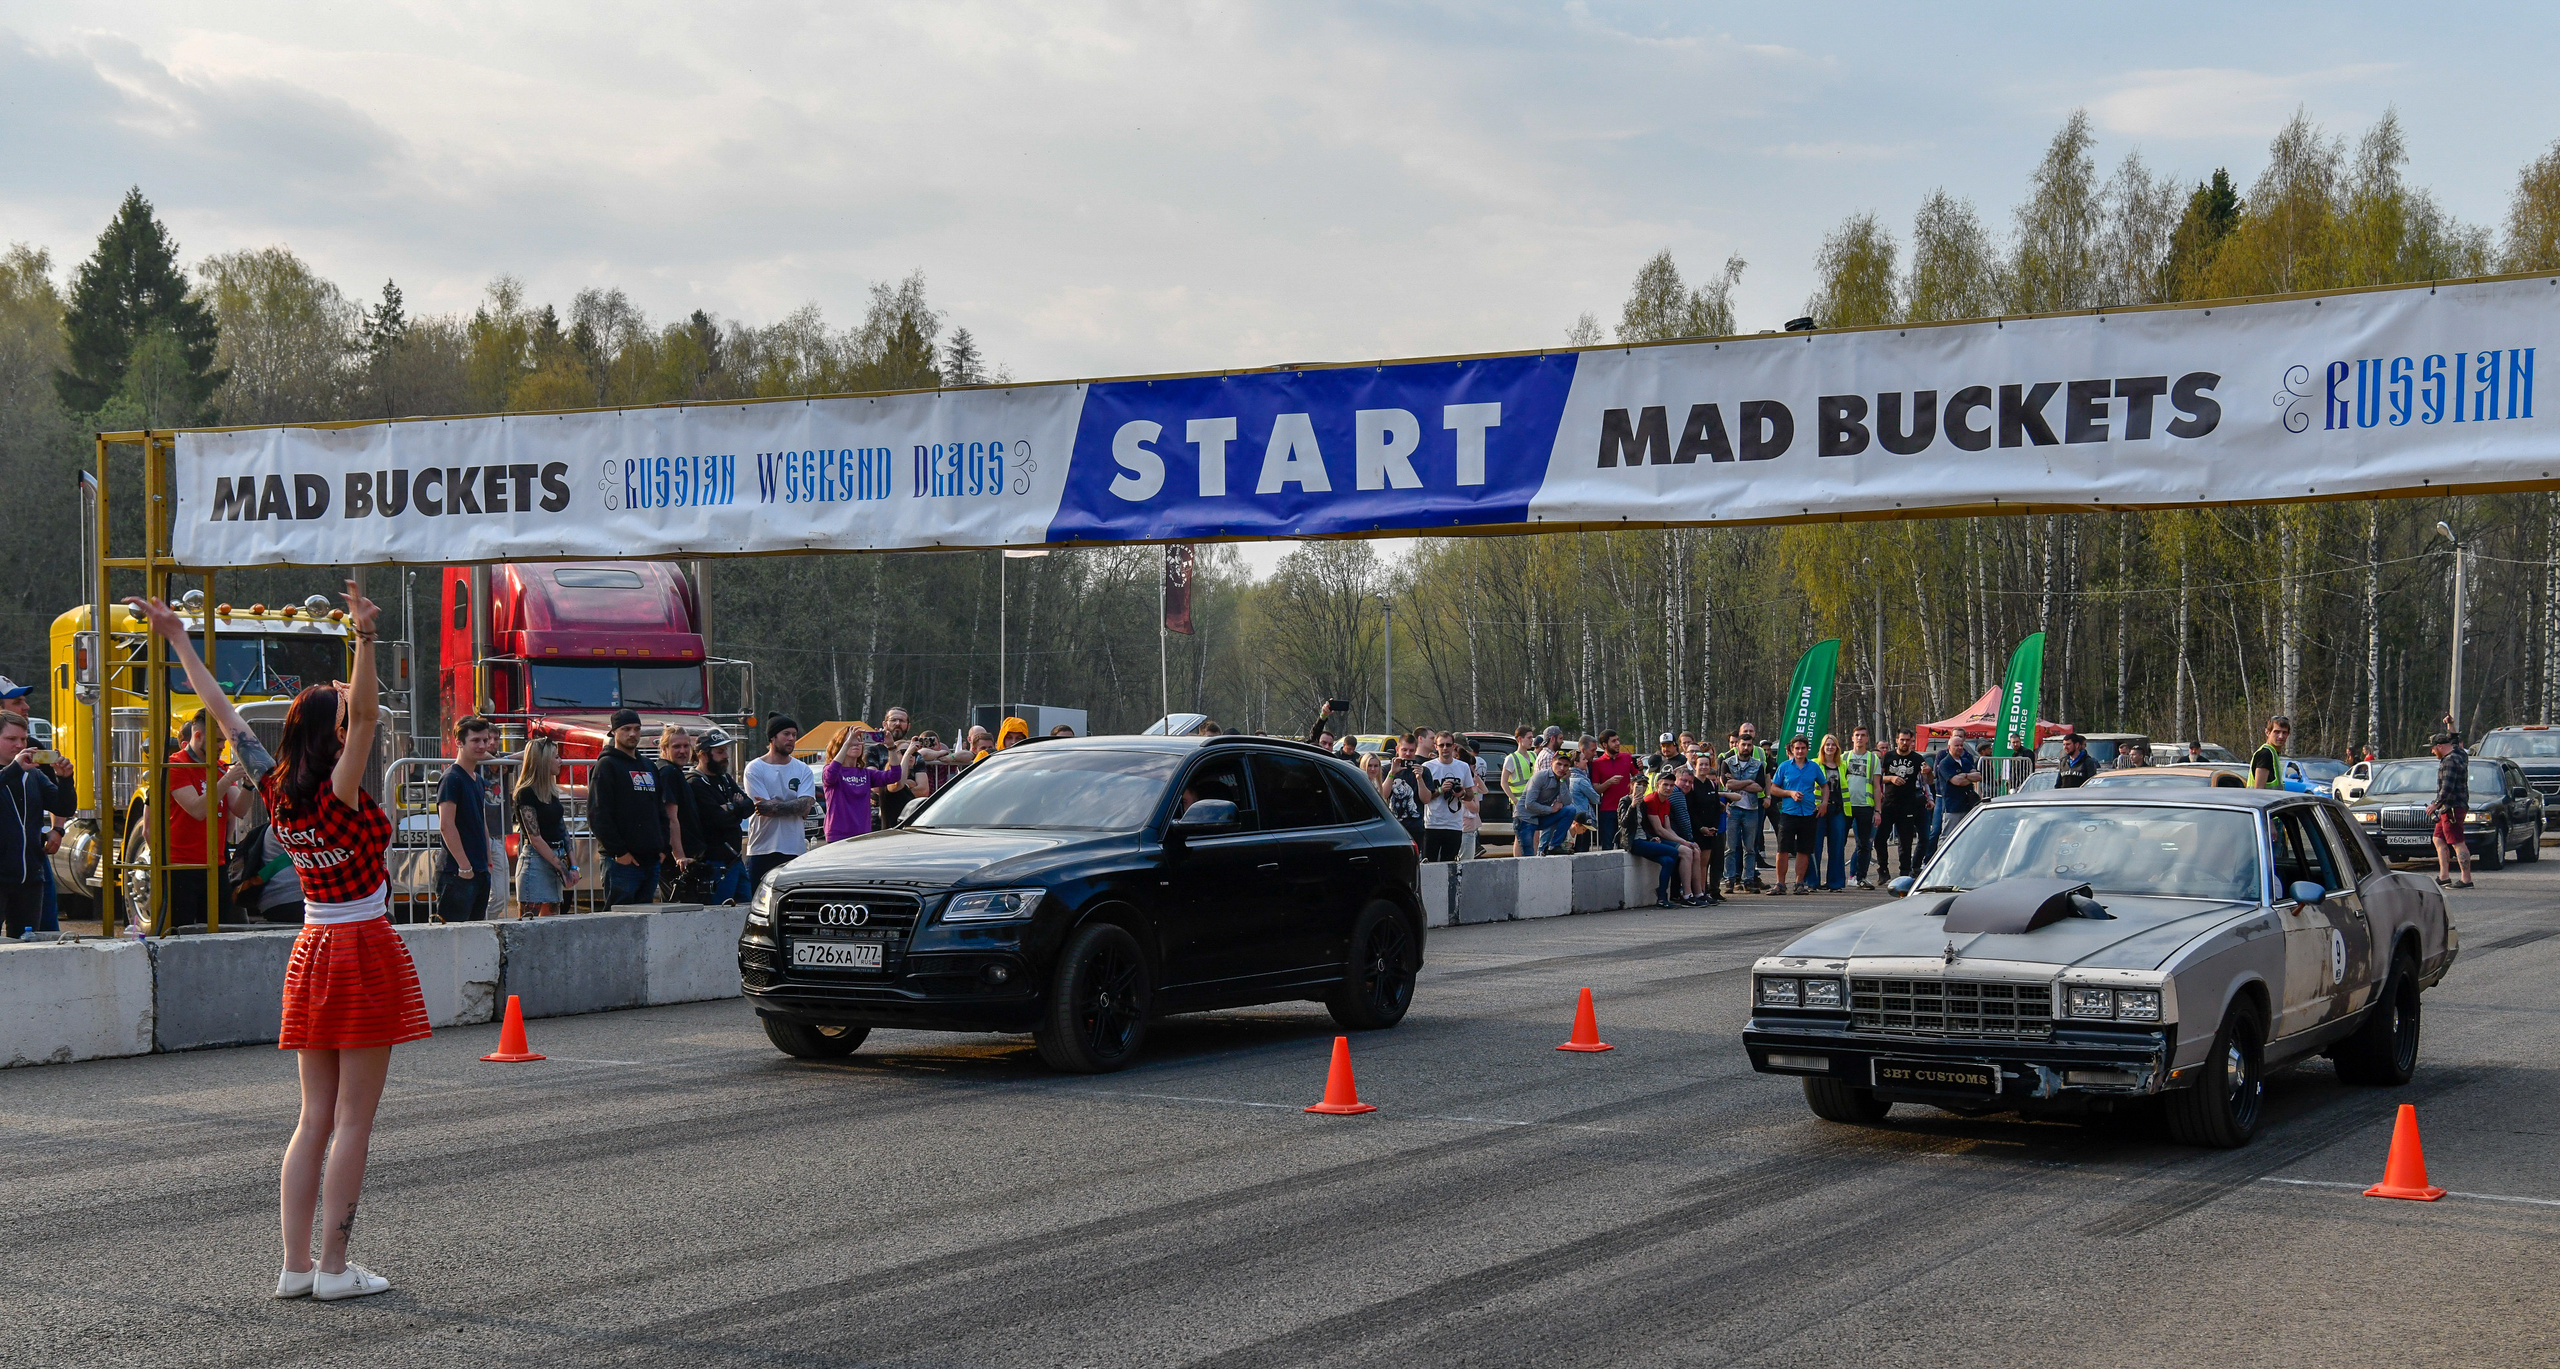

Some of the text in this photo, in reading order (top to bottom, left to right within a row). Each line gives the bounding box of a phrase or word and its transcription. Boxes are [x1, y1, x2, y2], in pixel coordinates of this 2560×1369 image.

[2323, 347, 2536, 430] RUSSIAN
[1596, 371, 2222, 469] MAD BUCKETS
[625, 441, 1004, 509] RUSSIAN WEEKEND DRAGS
[1108, 402, 1501, 502] START
[209, 461, 571, 522] MAD BUCKETS
[1796, 686, 1811, 734] EEDOM
[1893, 758, 1912, 767] RACE
[278, 825, 324, 847] Hey,
[283, 844, 355, 869] iss me.
[856, 946, 878, 960] 777
[1883, 1068, 1988, 1085] 3BT CUSTOMS
